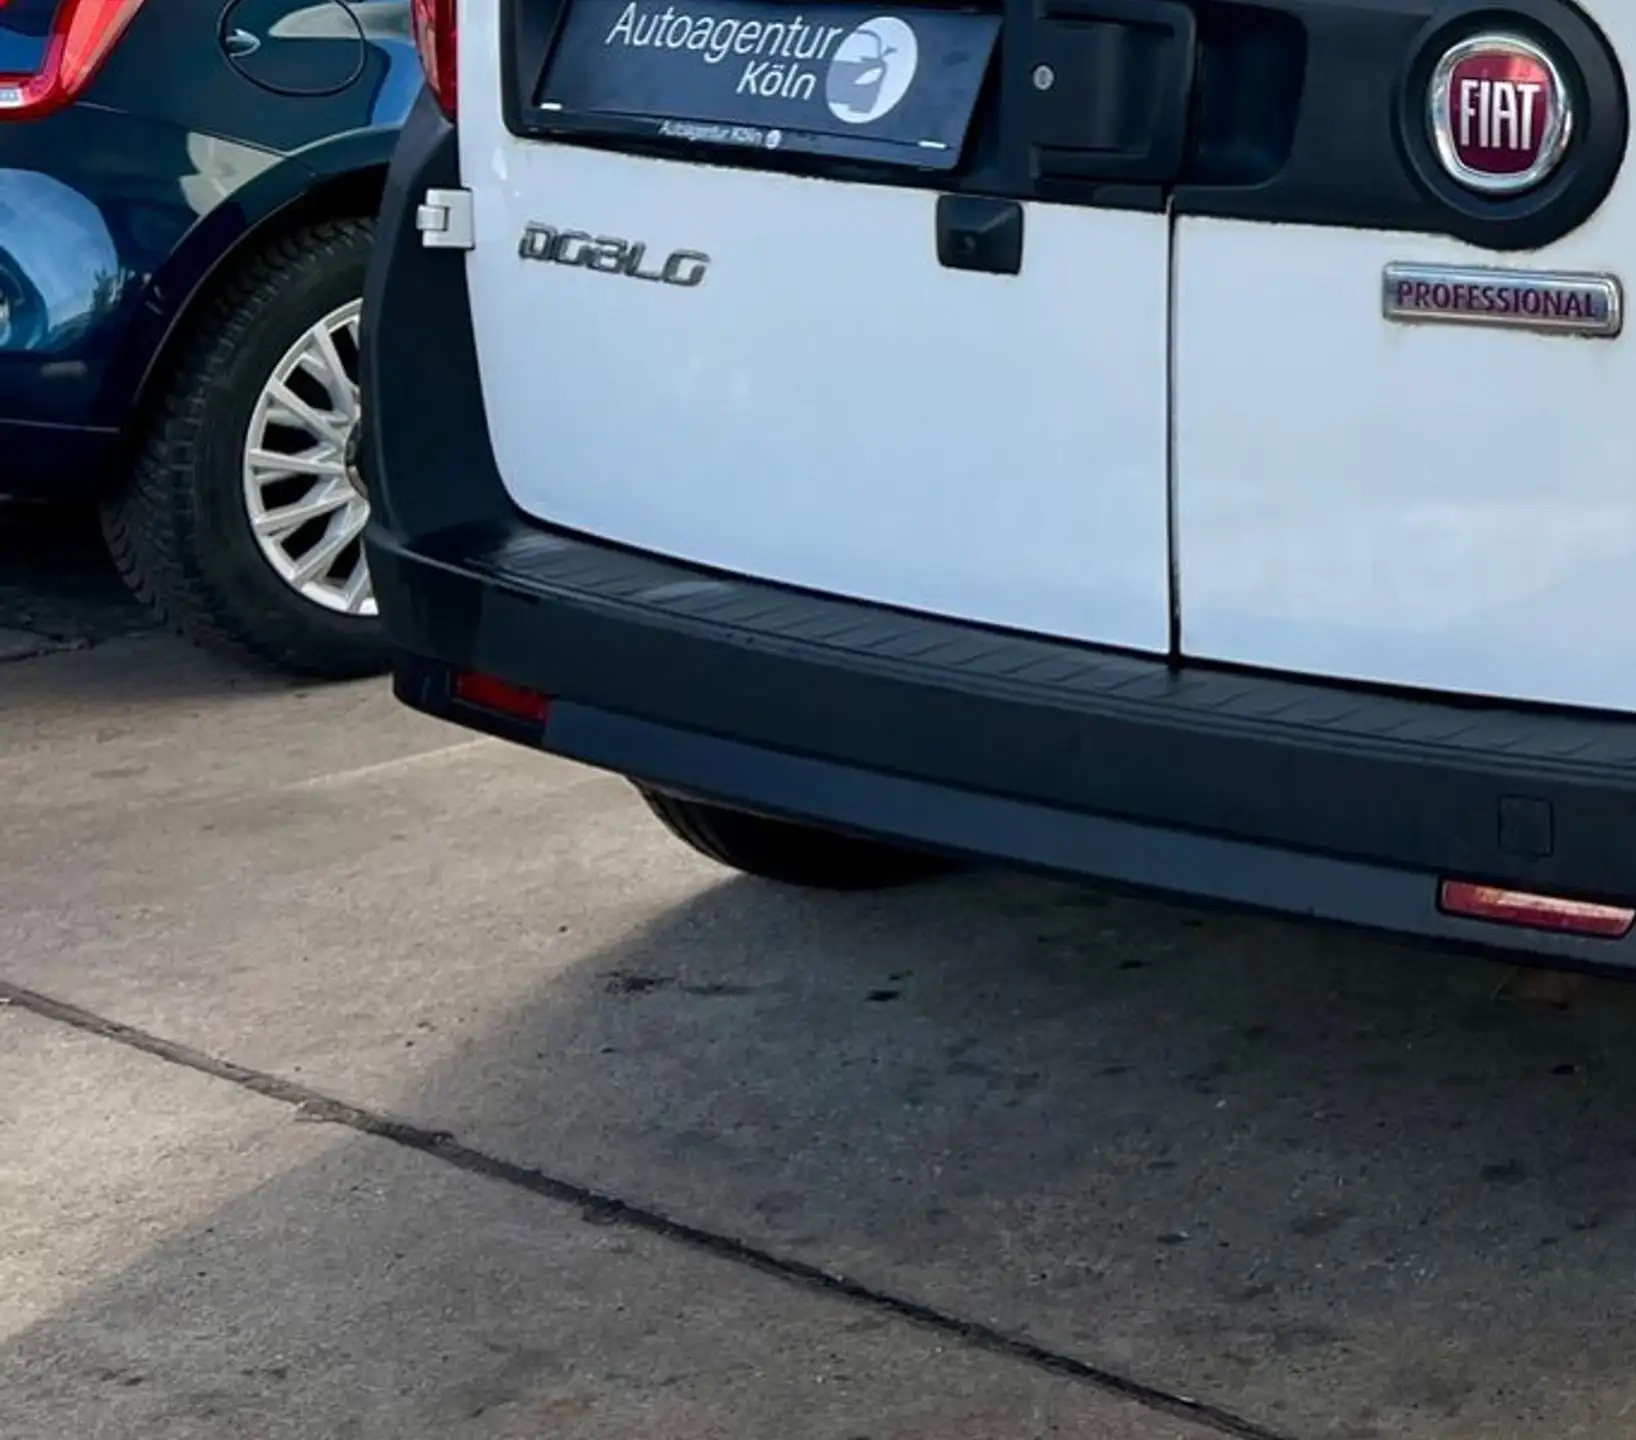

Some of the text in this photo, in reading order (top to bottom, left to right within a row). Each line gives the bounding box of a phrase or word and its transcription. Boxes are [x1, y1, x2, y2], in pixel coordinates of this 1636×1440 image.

[605, 0, 846, 63] Autoagentur
[735, 59, 818, 101] Köln
[1459, 77, 1541, 150] FIAT
[1396, 279, 1599, 318] PROFESSIONAL
